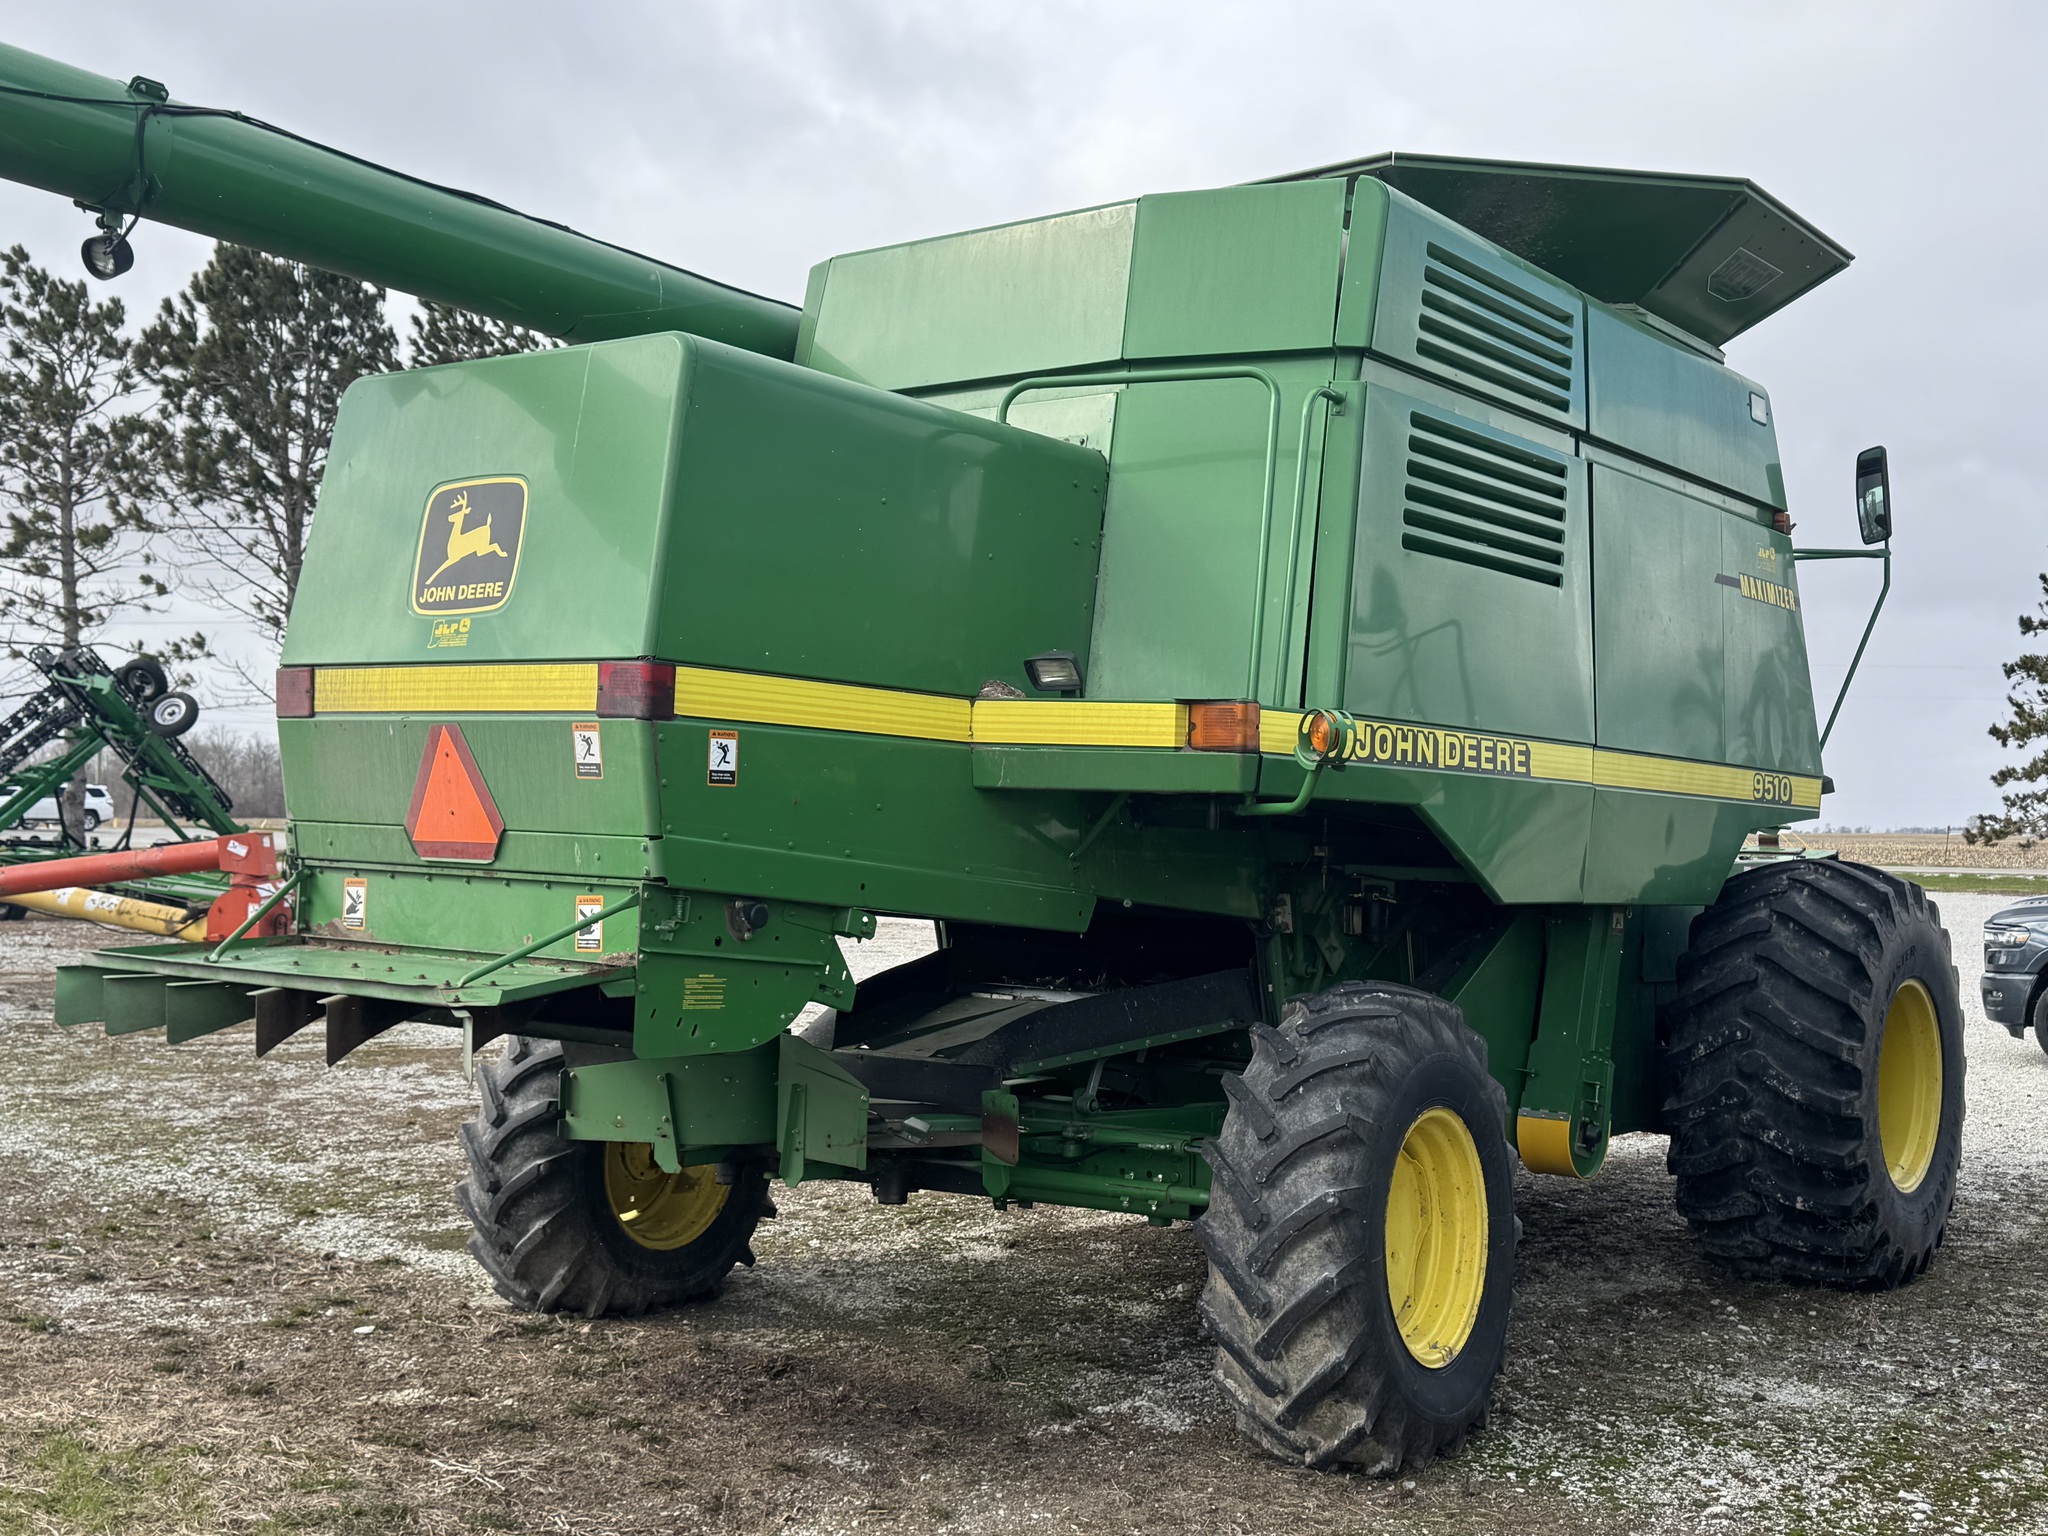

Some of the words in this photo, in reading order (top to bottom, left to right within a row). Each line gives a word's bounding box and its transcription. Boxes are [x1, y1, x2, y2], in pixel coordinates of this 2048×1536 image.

[419, 585, 456, 604] JOHN
[458, 581, 504, 600] DEERE
[1740, 573, 1796, 612] MAXIMIZER
[1355, 725, 1436, 764] JOHN
[1444, 732, 1529, 774] DEERE
[1753, 772, 1792, 803] 9510
